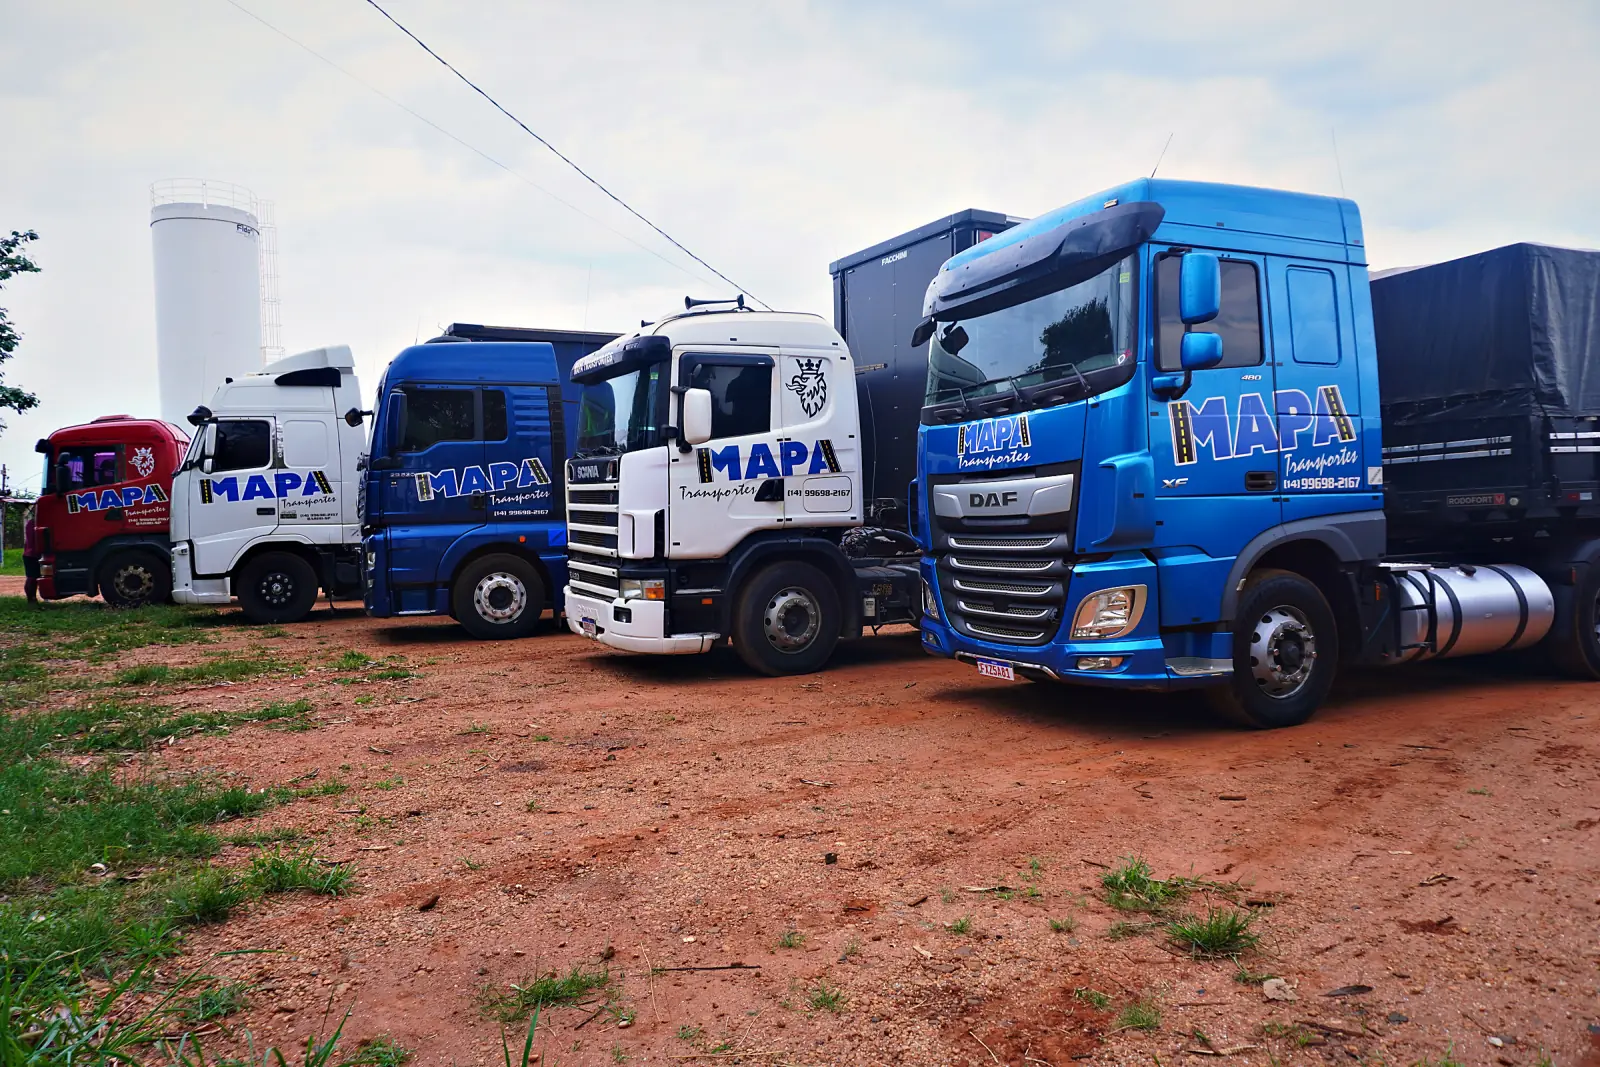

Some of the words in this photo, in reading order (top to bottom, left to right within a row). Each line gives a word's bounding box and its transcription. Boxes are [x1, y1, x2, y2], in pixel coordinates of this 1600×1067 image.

[882, 250, 908, 266] FACCHINI
[1167, 385, 1357, 466] MAPA
[957, 414, 1032, 455] MAPA
[696, 439, 842, 484] MAPA
[957, 450, 1031, 469] Transportes
[1284, 447, 1358, 476] Transportes
[415, 457, 552, 502] MAPA
[577, 465, 599, 479] SCANIA
[199, 470, 335, 504] MAPA
[1162, 478, 1188, 489] XF
[1301, 477, 1360, 490] 99698-2167
[66, 483, 169, 514] MAPA
[490, 489, 550, 505] Transportes
[680, 484, 757, 502] Transportes
[970, 491, 1018, 508] DAF
[1448, 496, 1493, 505] RODOFORT
[281, 495, 337, 509] Transportes
[124, 506, 166, 516] Transportes
